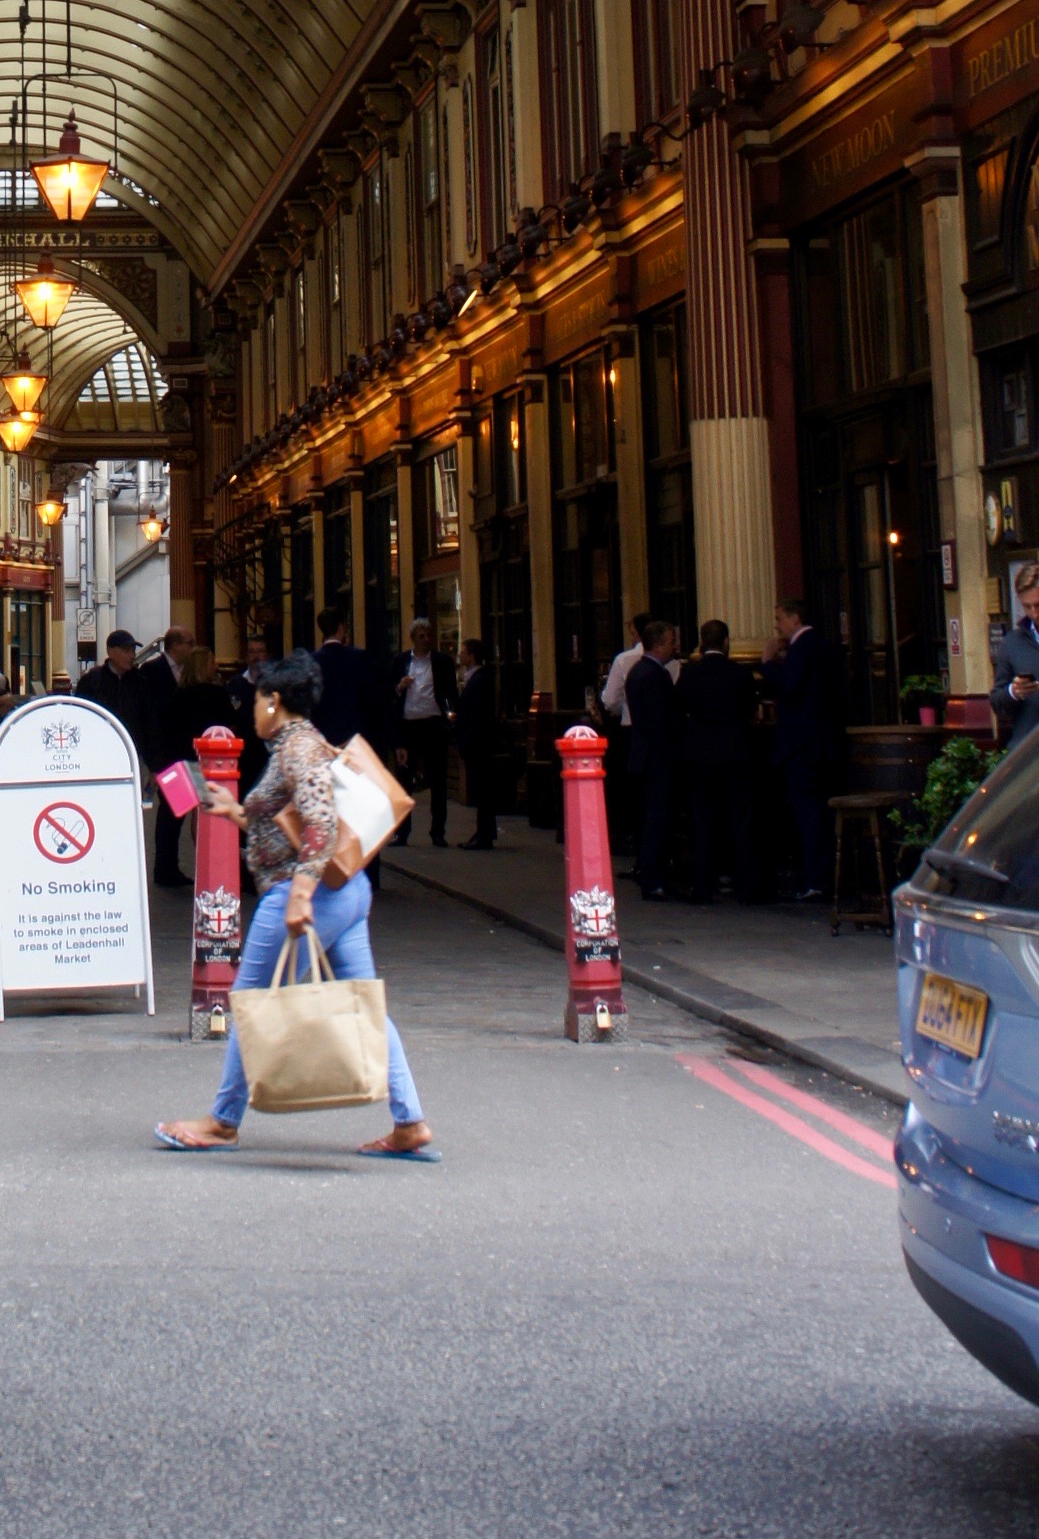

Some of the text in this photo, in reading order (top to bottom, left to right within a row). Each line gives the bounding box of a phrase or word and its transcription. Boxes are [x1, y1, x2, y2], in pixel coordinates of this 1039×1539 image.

[848, 109, 898, 172] MOON
[45, 763, 81, 771] LONDON
[21, 879, 116, 895] No Smoking
[18, 910, 122, 924] It is against the law
[13, 923, 129, 937] to smoke in enclosed
[19, 937, 125, 951] areas of Leadenhall
[54, 953, 91, 964] Market
[213, 947, 223, 956] OF
[204, 955, 231, 963] LONDON
